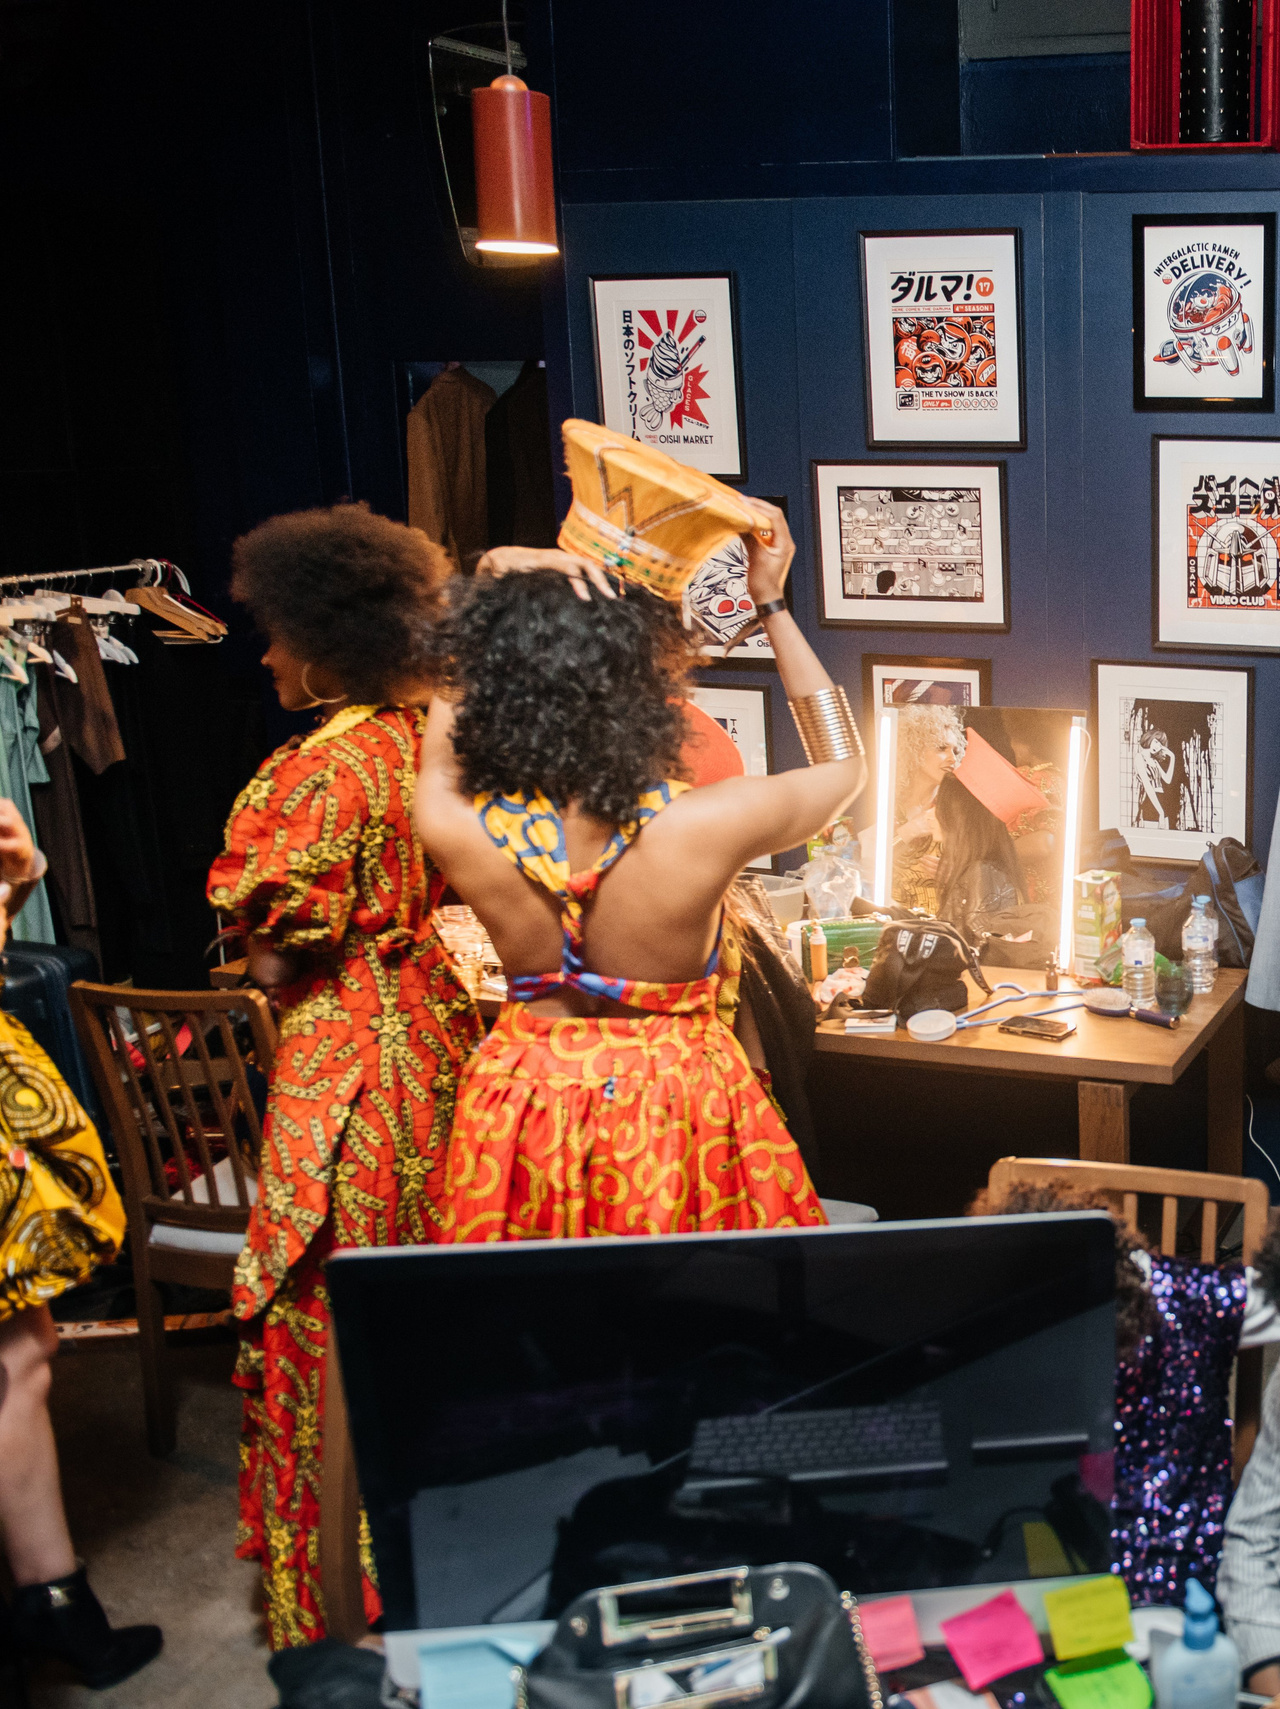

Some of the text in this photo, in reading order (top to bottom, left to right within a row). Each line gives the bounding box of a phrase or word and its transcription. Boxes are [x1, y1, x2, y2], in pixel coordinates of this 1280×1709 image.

[1153, 242, 1240, 277] INTERGALACTIC RAMEN
[1170, 254, 1252, 289] DELIVERY!
[978, 282, 991, 293] 17
[684, 375, 694, 412] GLACES
[659, 434, 680, 444] OISHI
[683, 435, 713, 444] MARKET
[1209, 595, 1265, 606] VIDEO CLUB
[757, 639, 770, 648] Ois
